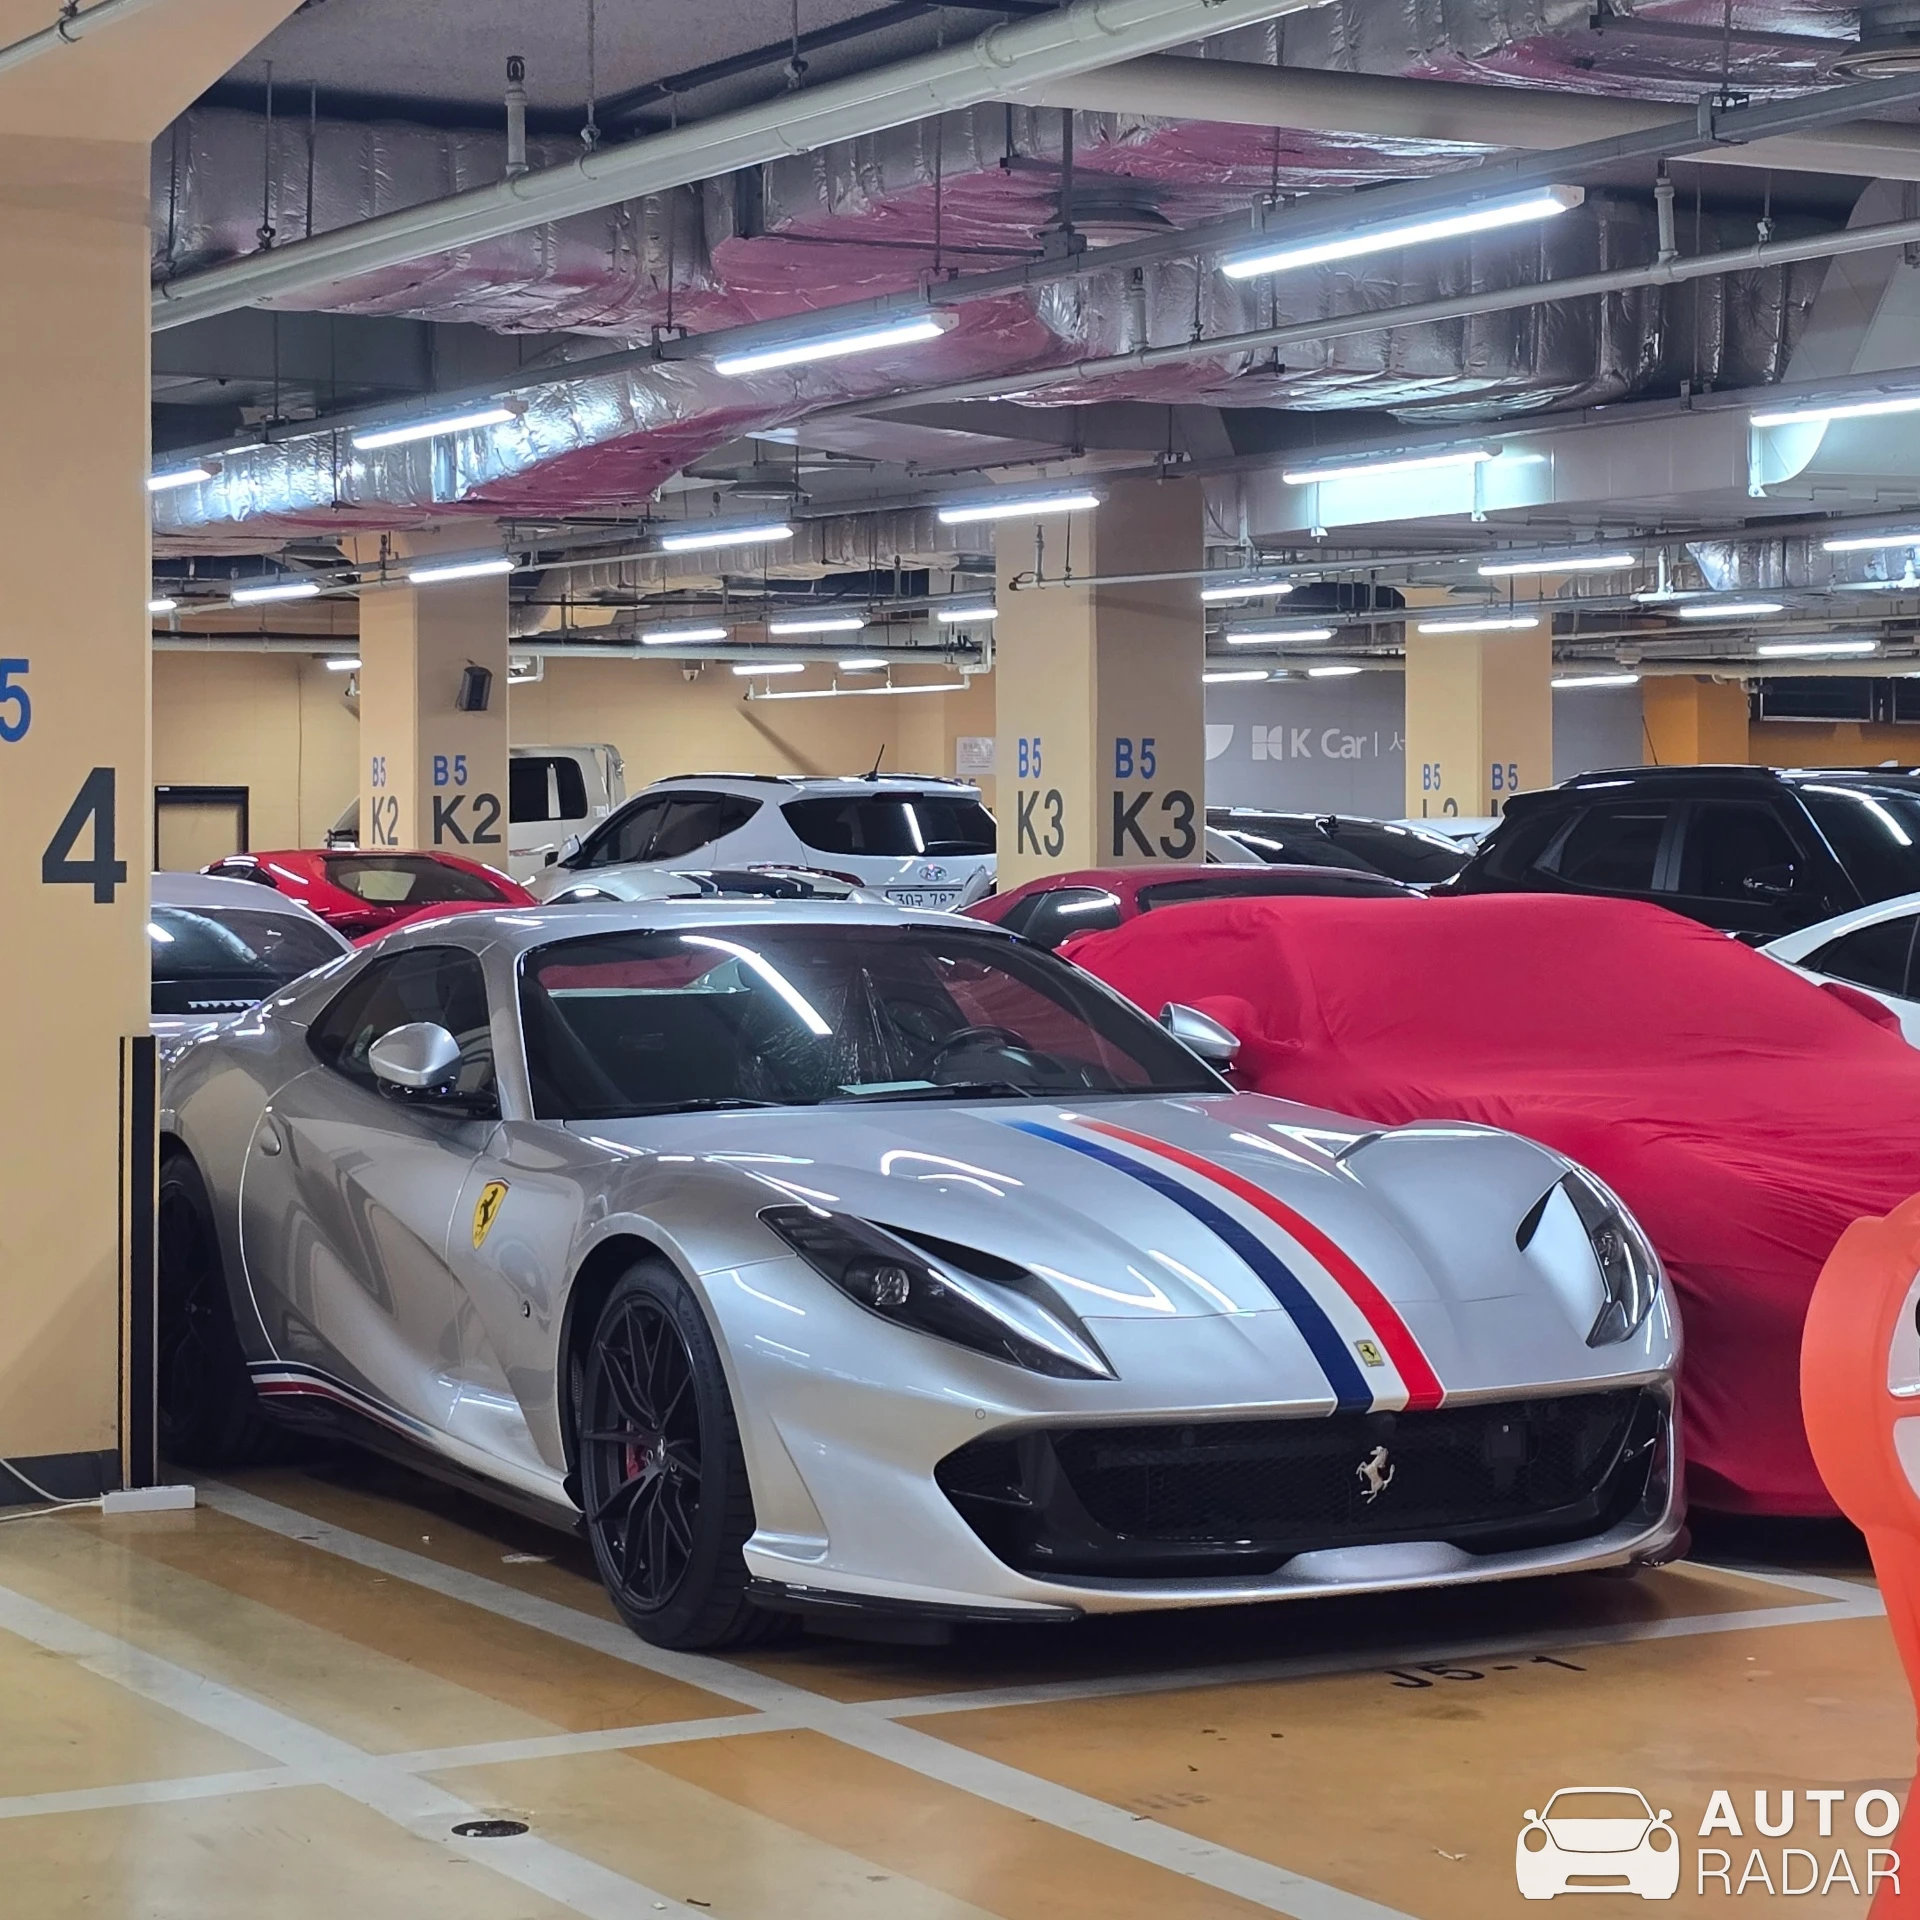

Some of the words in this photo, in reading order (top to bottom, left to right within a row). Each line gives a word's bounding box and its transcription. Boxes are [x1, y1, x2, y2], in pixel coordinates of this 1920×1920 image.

[0, 658, 32, 743] 5
[1018, 737, 1042, 779] B5
[1115, 737, 1156, 780] B5
[1290, 728, 1312, 758] K
[1321, 728, 1368, 759] Car
[372, 756, 387, 787] B5
[433, 755, 468, 786] B5
[1423, 763, 1442, 791] B5
[1491, 763, 1518, 791] B5
[42, 766, 128, 904] 4
[371, 795, 399, 846] K2
[432, 793, 502, 845] K2
[1017, 788, 1065, 858] K3
[1113, 789, 1197, 860] K3
[1384, 1655, 1588, 1689] J5-1
